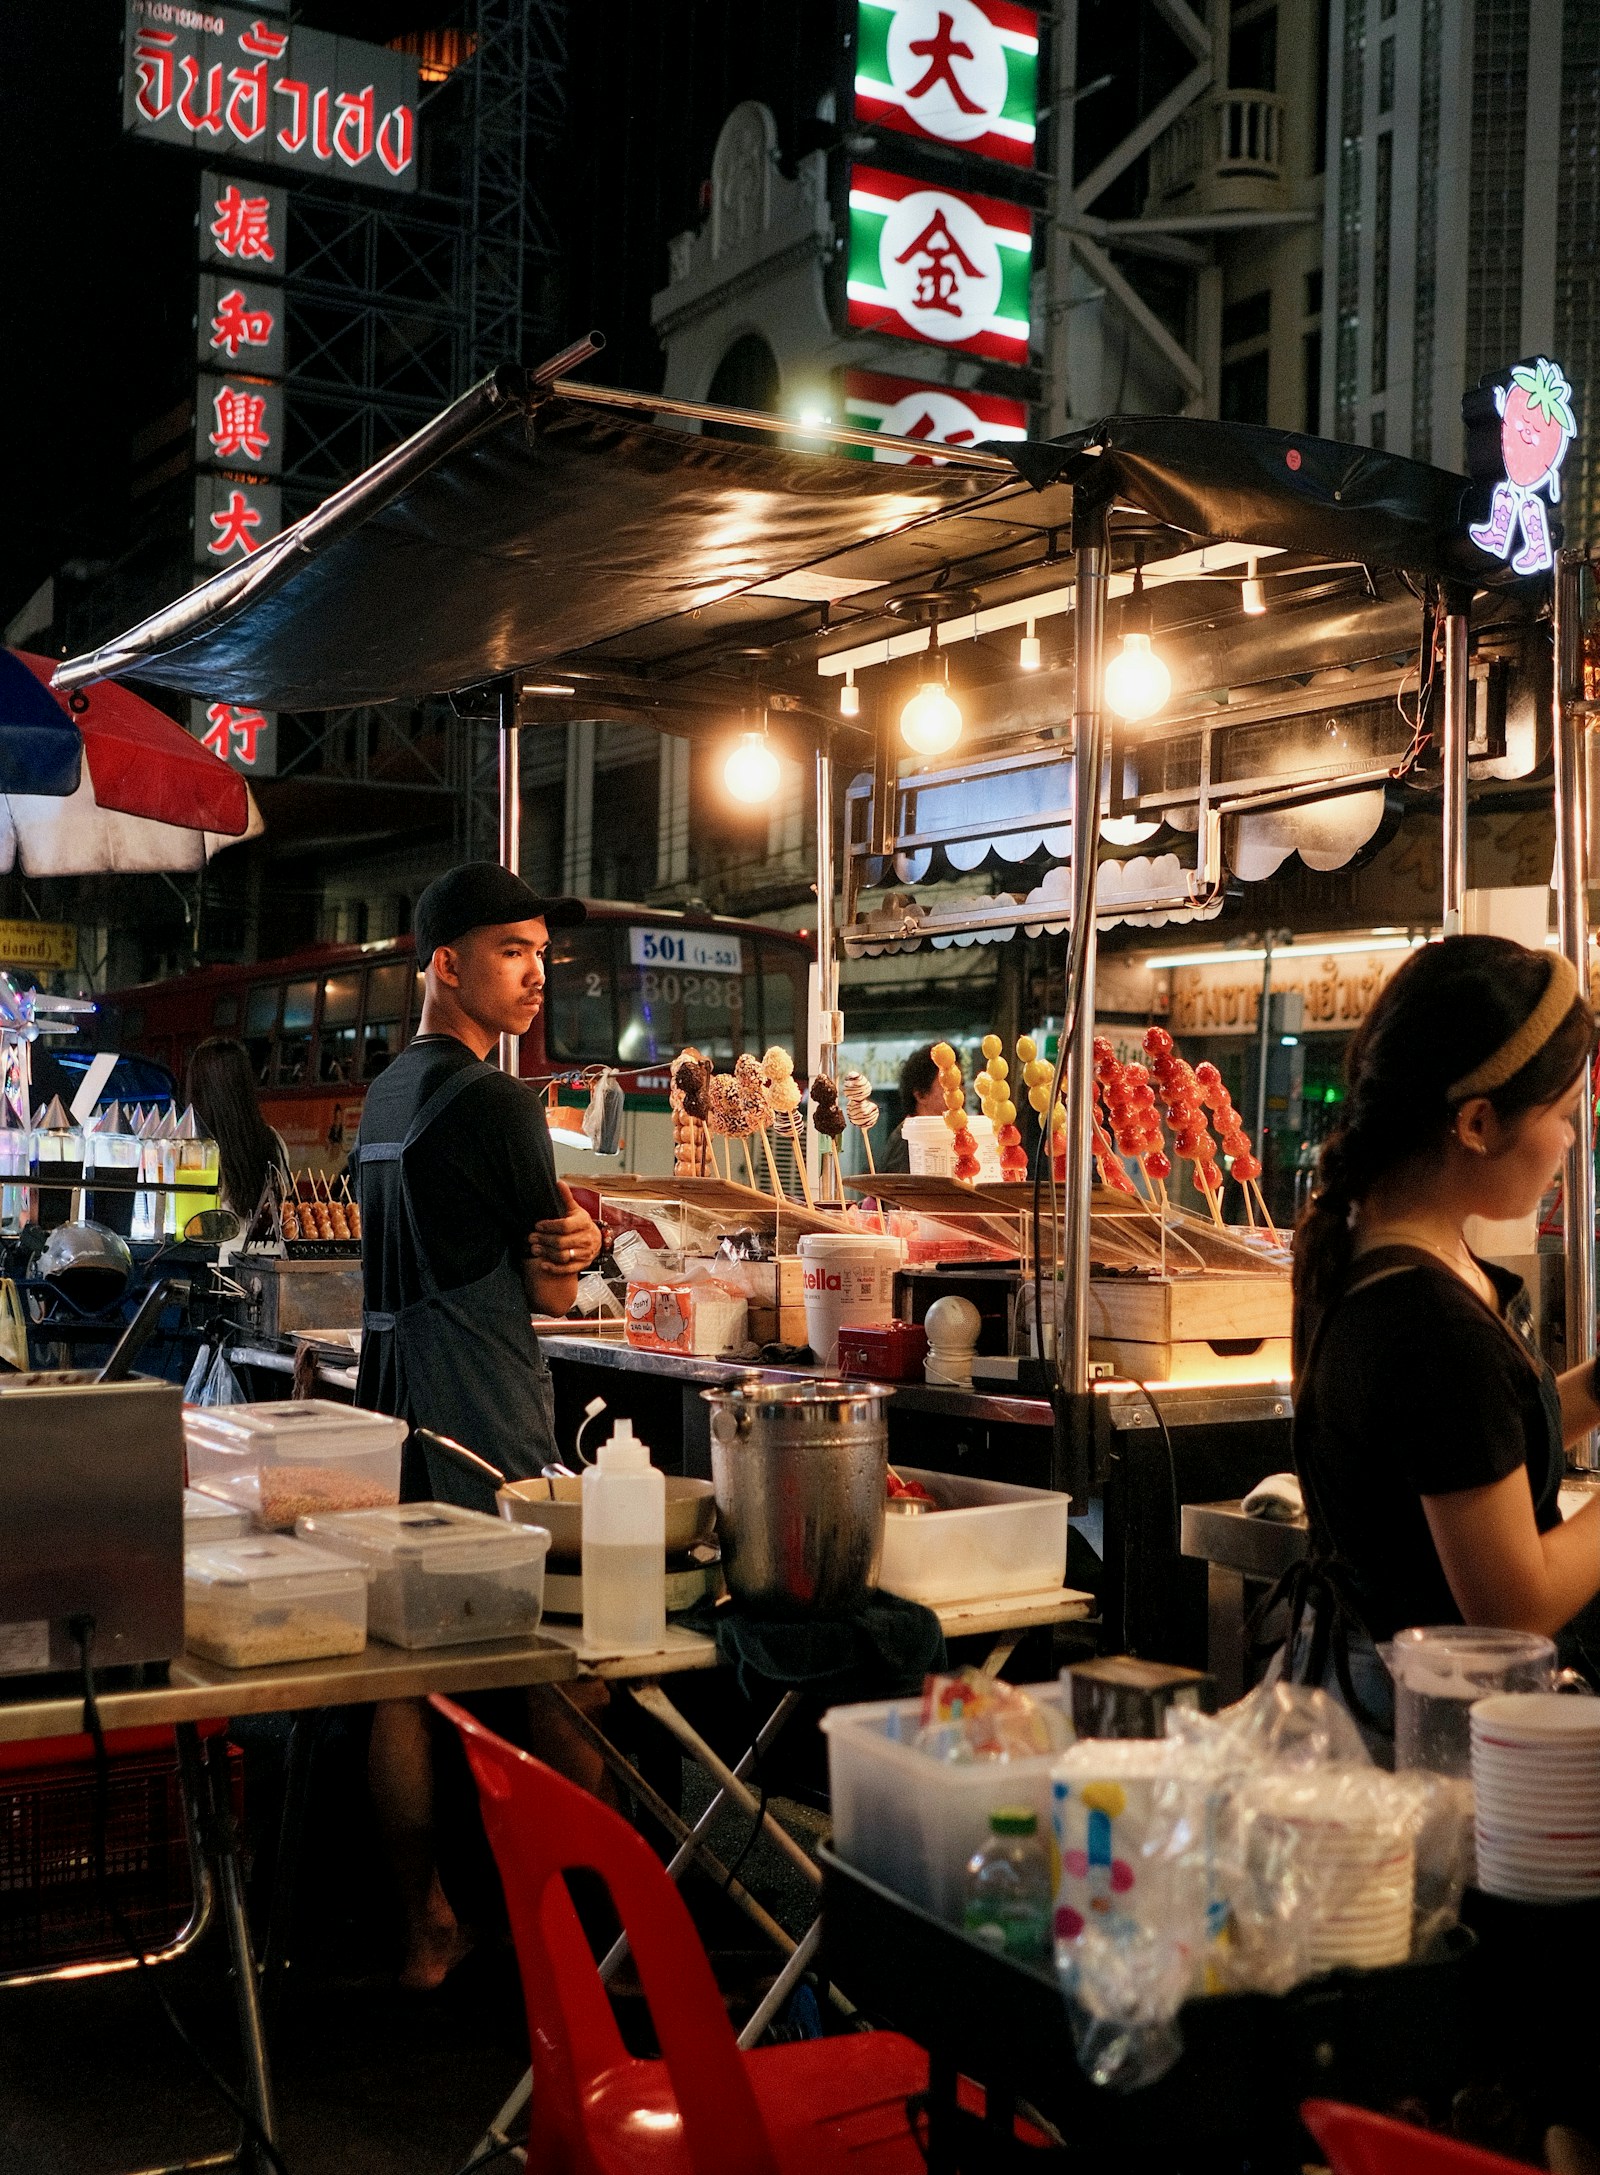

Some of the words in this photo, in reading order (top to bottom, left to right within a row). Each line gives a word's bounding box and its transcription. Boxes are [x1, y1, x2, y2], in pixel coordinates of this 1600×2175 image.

[133, 19, 413, 176] จินฮั้วเฮง
[643, 933, 687, 963] 501
[586, 973, 603, 997] 2
